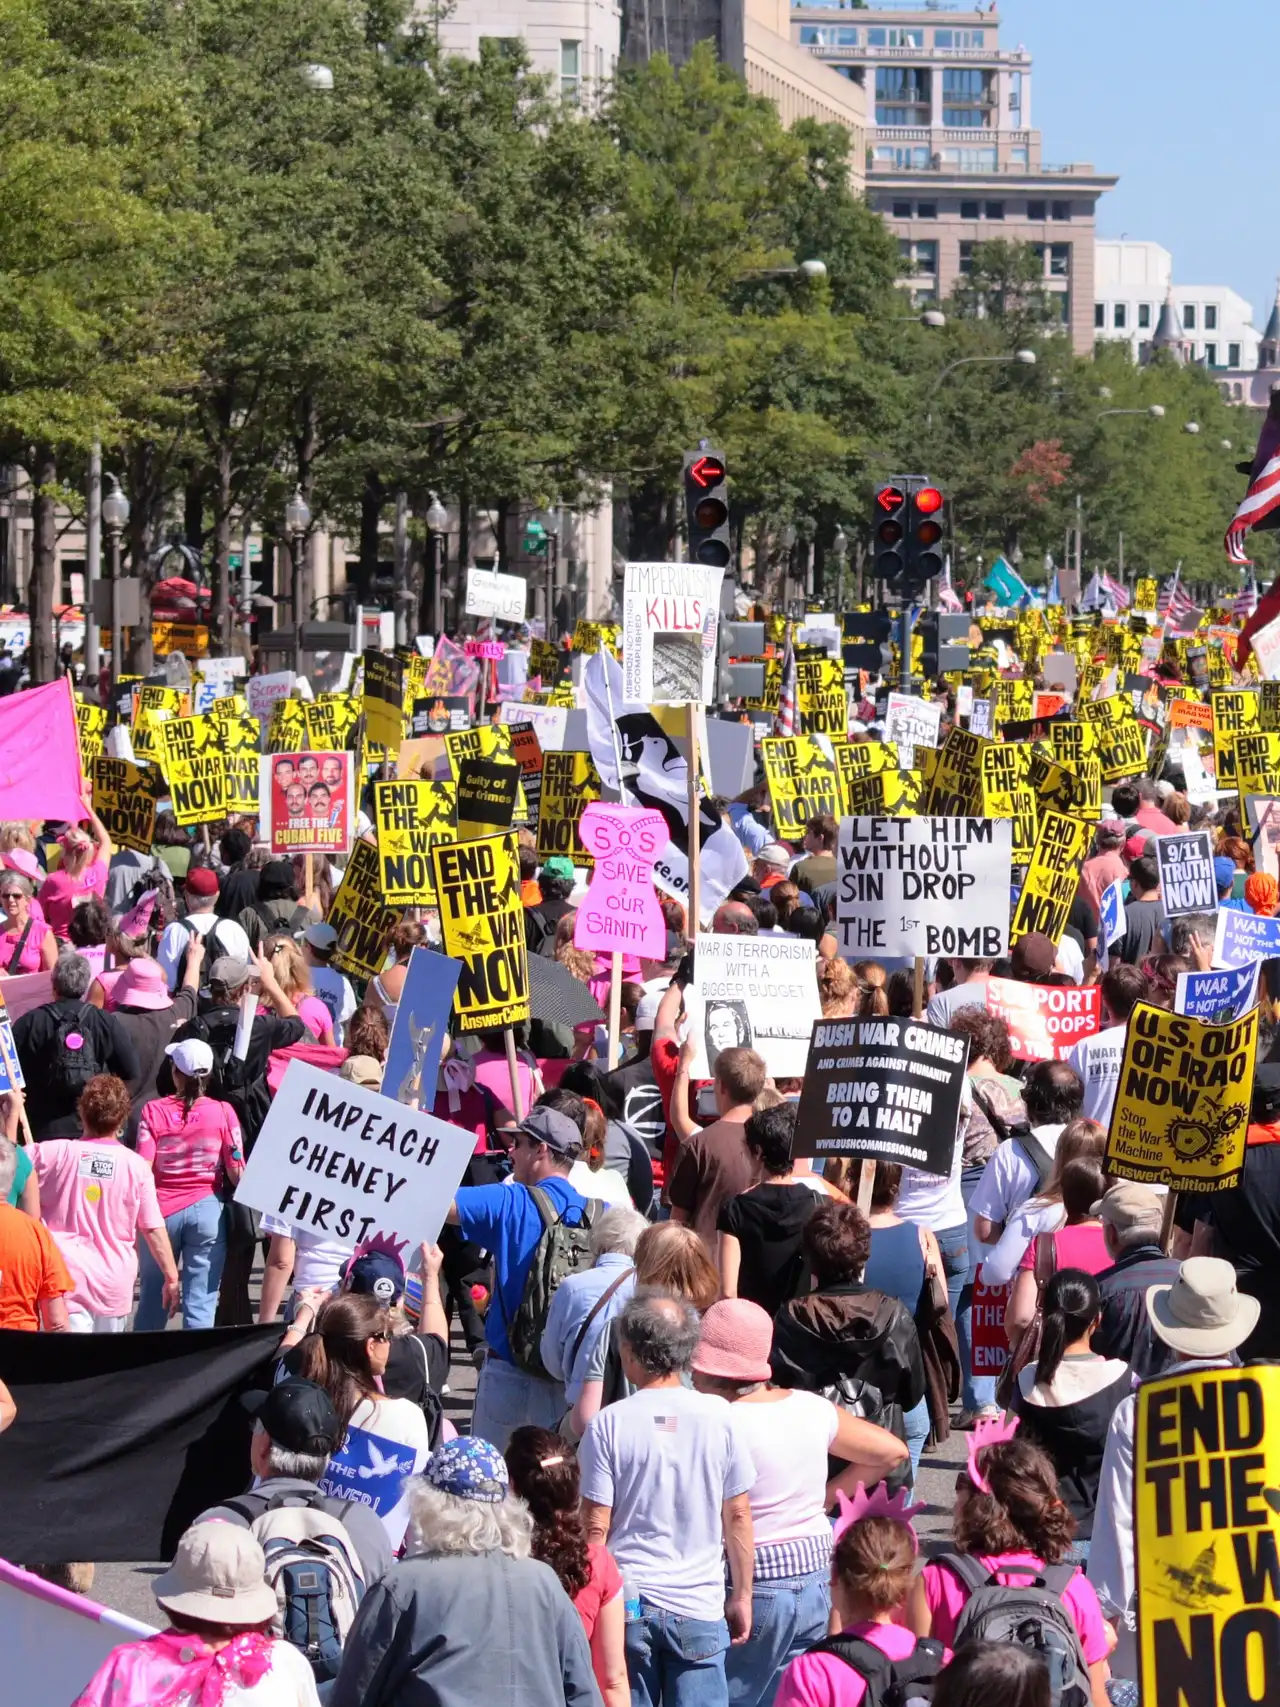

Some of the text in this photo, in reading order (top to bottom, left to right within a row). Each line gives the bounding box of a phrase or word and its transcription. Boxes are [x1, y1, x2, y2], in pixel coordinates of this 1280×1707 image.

[646, 597, 701, 630] KILLS
[275, 827, 343, 844] CUBAN FIVE
[290, 816, 329, 829] FREE THE
[852, 817, 912, 842] LET
[595, 826, 656, 852] S O S
[1168, 843, 1200, 862] 9/11
[841, 844, 966, 872] WITHOUT
[1162, 862, 1210, 881] TRUTH
[602, 862, 647, 883] SAVE
[841, 872, 975, 901] SIN DROP
[1166, 881, 1213, 908] NOW
[606, 896, 644, 914] OUR
[586, 912, 647, 942] SANITY
[839, 918, 886, 948] THE
[926, 925, 1001, 956] BOMB
[1233, 917, 1266, 935] WAR
[698, 942, 813, 960] WAR IS TERRORISM
[1226, 931, 1274, 949] IS NOT THE
[726, 963, 770, 978] WITH A
[702, 983, 804, 998] BIGGER BUDGET
[815, 1022, 964, 1063] BUSH WAR CRIMES
[1136, 1010, 1255, 1058] U.S. OUT
[817, 1057, 952, 1084] AND CRIMES AGAINST HUMANITY
[1132, 1040, 1173, 1075] OF
[1179, 1052, 1246, 1088] IRAQ
[826, 1081, 932, 1114] BRING THEM
[1125, 1068, 1200, 1115] NOW
[301, 1088, 440, 1166] IMPEACH
[831, 1106, 922, 1137] TO A HALT
[1121, 1107, 1147, 1127] Stop
[1118, 1126, 1161, 1146] the War
[816, 1139, 928, 1162] WWW.BUSHCOMMISSION.ORG
[1115, 1140, 1163, 1162] Machine
[288, 1137, 407, 1203] CHENEY
[278, 1185, 376, 1244] FIRST
[1145, 1378, 1265, 1463] END
[1145, 1453, 1268, 1538] THE
